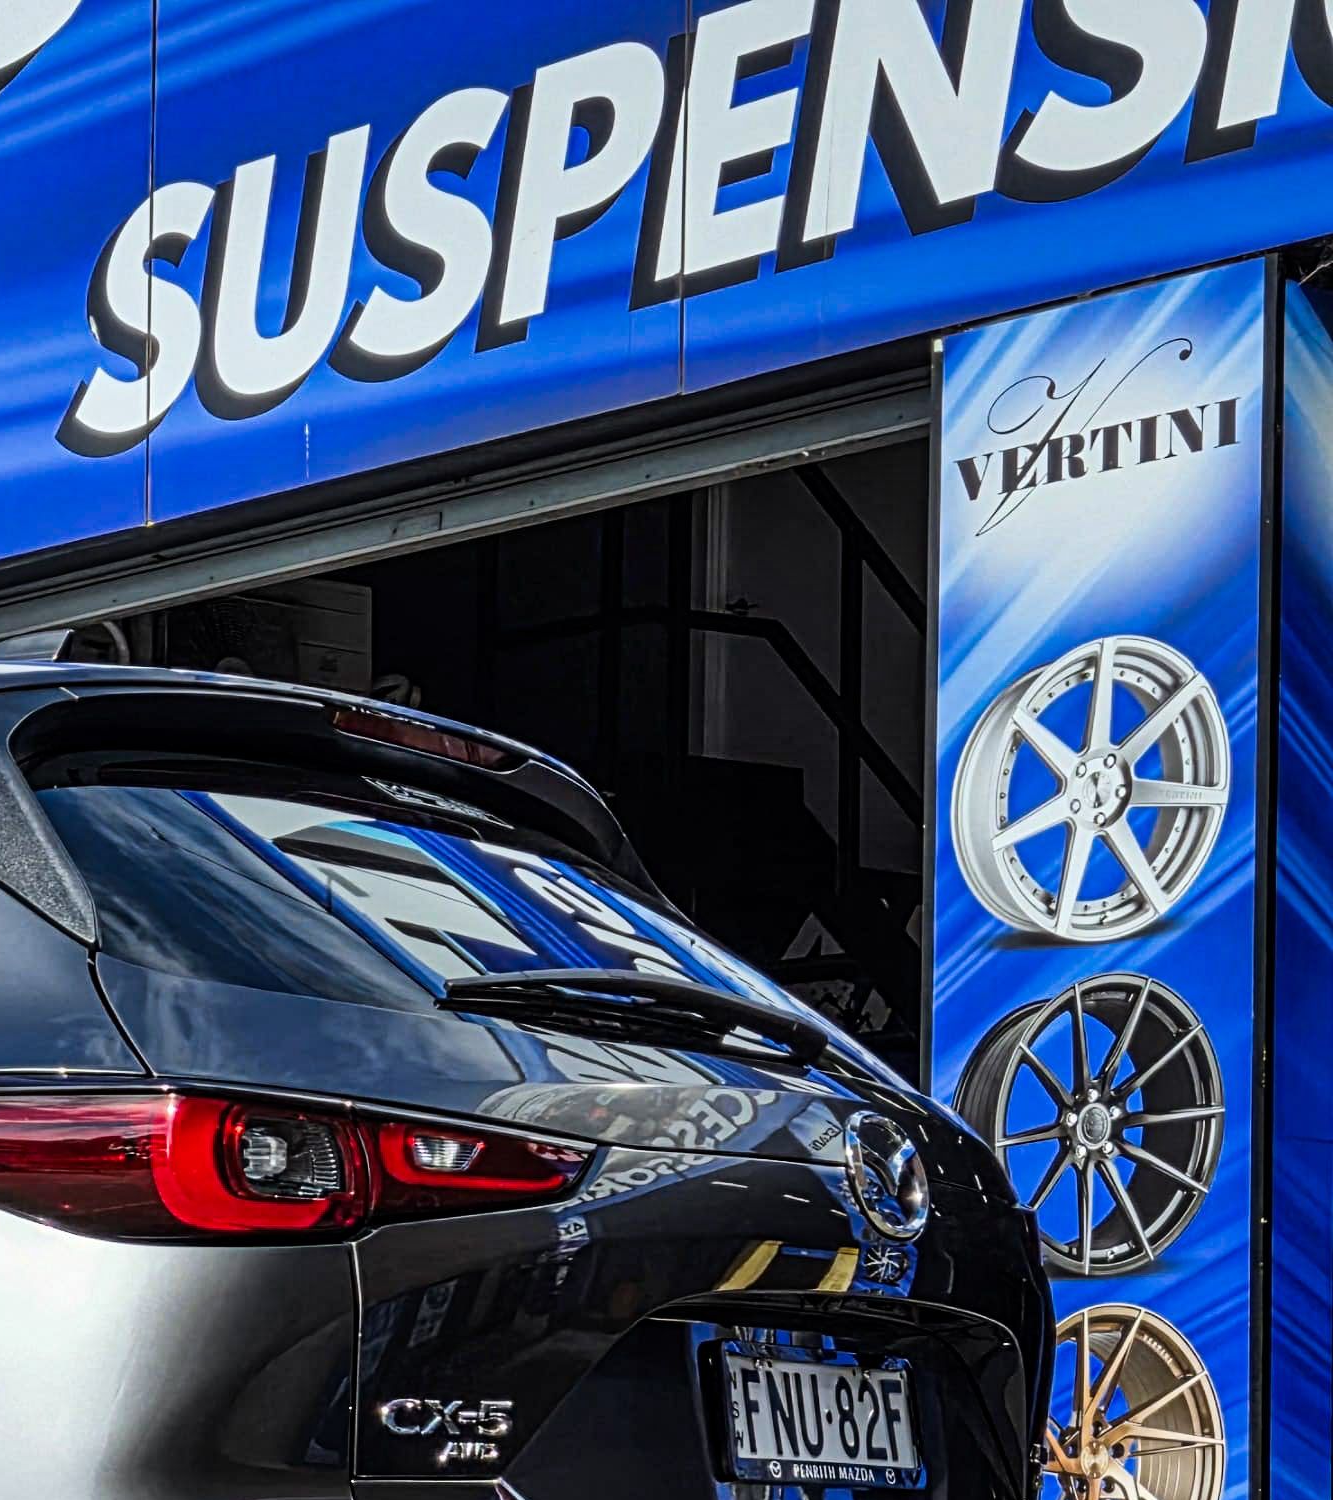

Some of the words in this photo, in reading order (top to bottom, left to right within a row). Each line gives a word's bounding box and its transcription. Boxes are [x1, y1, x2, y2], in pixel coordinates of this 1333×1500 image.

[953, 396, 1241, 502] VERTINI
[382, 1399, 513, 1435] CX-5
[793, 1462, 836, 1480] PENRITH
[838, 1465, 875, 1482] MAZDA
